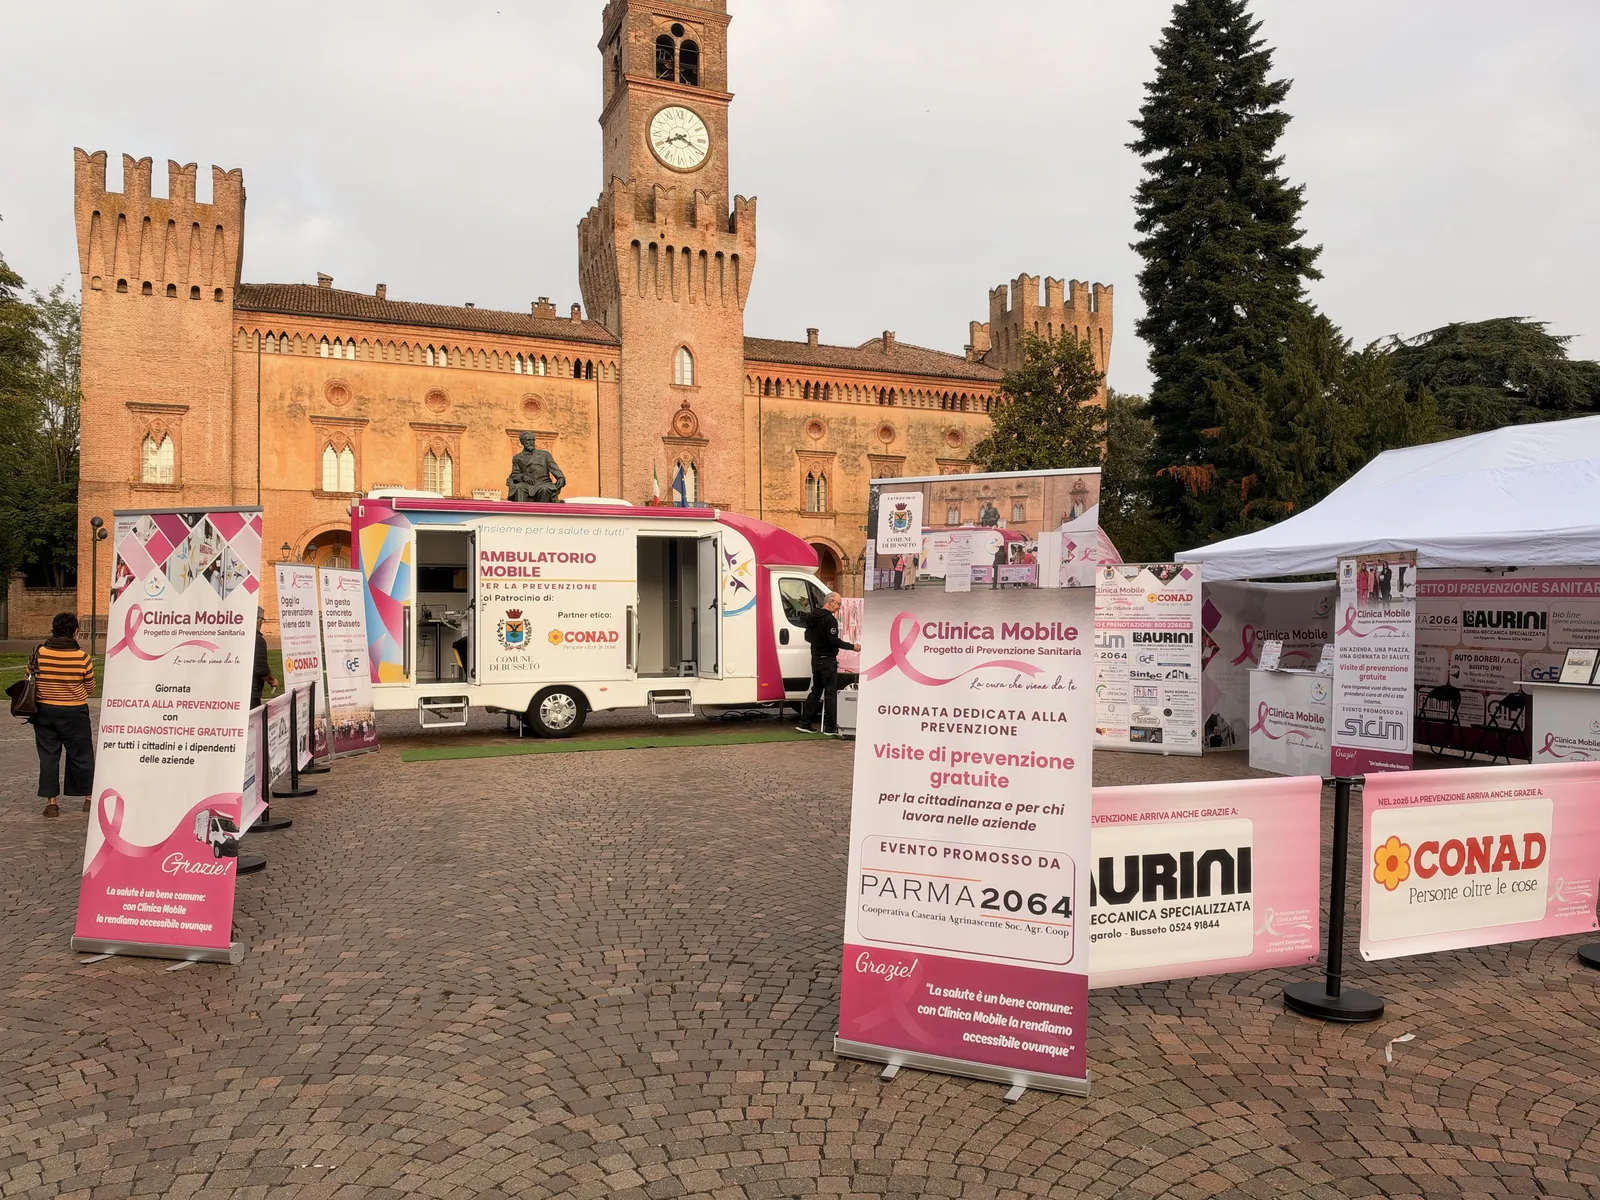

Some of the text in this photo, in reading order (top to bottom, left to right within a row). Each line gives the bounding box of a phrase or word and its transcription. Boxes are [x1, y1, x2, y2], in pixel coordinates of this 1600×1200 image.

[525, 527, 543, 536] per
[546, 525, 555, 535] la
[558, 527, 590, 535] salute
[592, 527, 602, 535] di
[481, 551, 596, 563] AMBULATORIO
[481, 566, 540, 577] MOBILE
[1448, 583, 1458, 593] DI
[1460, 583, 1538, 593] PREVENZIONE
[281, 597, 293, 607] Oggi
[334, 599, 350, 607] gesto
[1158, 594, 1193, 602] CONAD
[144, 611, 243, 625] Clinica Mobile
[282, 608, 313, 618] prevenzione
[1357, 610, 1382, 618] Clinica
[1552, 610, 1580, 618] bio line
[283, 620, 297, 628] viene
[327, 621, 337, 630] per
[564, 631, 619, 643] CONAD
[922, 622, 994, 640] Clinica
[1001, 622, 1078, 641] Mobile
[1256, 629, 1328, 640] Clinica Mobile
[924, 645, 1081, 656] Progetto di Prevenzione Sanitaria
[294, 657, 318, 670] CONAD
[1474, 655, 1500, 663] BORERI
[501, 663, 540, 671] BUSSETO
[1130, 671, 1162, 679] Sintec
[155, 684, 190, 693] Giornata
[107, 699, 240, 710] DEDICATA ALLA PREVENZIONE
[878, 705, 1067, 722] GIORNATA DEDICATA ALLA
[1268, 708, 1324, 724] Clinica Mobile
[101, 725, 244, 737] VISITE DIAGNOSTICHE GRATUITE
[921, 722, 1018, 736] PREVENZIONE
[1578, 737, 1600, 746] Mobile
[140, 755, 194, 765] delle aziende
[873, 743, 1075, 770] Visite di prevenzione
[1336, 749, 1357, 759] Grazie!
[930, 770, 1009, 789] gratuite
[1378, 797, 1392, 806] NEL
[1410, 796, 1419, 804] LA
[1419, 793, 1465, 803] PREVENZIONE
[1466, 791, 1490, 800] ARRIVA
[1490, 790, 1512, 798] ANCHE
[1513, 789, 1536, 798] GRAZIE
[1537, 788, 1543, 796] A:
[1139, 811, 1170, 821] ARRIVA
[1171, 810, 1199, 819] ANCHE
[1200, 808, 1230, 817] GRAZIE
[1231, 808, 1238, 816] A:
[902, 810, 1036, 832] lavora nelle aziende
[881, 842, 1061, 870] EVENTO PROMOSSO DA
[1414, 832, 1547, 879] CONAD
[162, 852, 233, 876] Grazie!
[861, 874, 1072, 919] PARMA2064
[1409, 877, 1538, 904] Persone oltre le cose
[1090, 901, 1250, 926] ECCANICA SPECIALIZZATA
[862, 904, 1069, 938] Cooperativa Casearia Agrinascente Soc. Agr. Coop
[1130, 926, 1166, 936] Busseto
[1169, 923, 1192, 933] 0524
[1194, 920, 1220, 930] 91844
[855, 951, 918, 981] Grazie!
